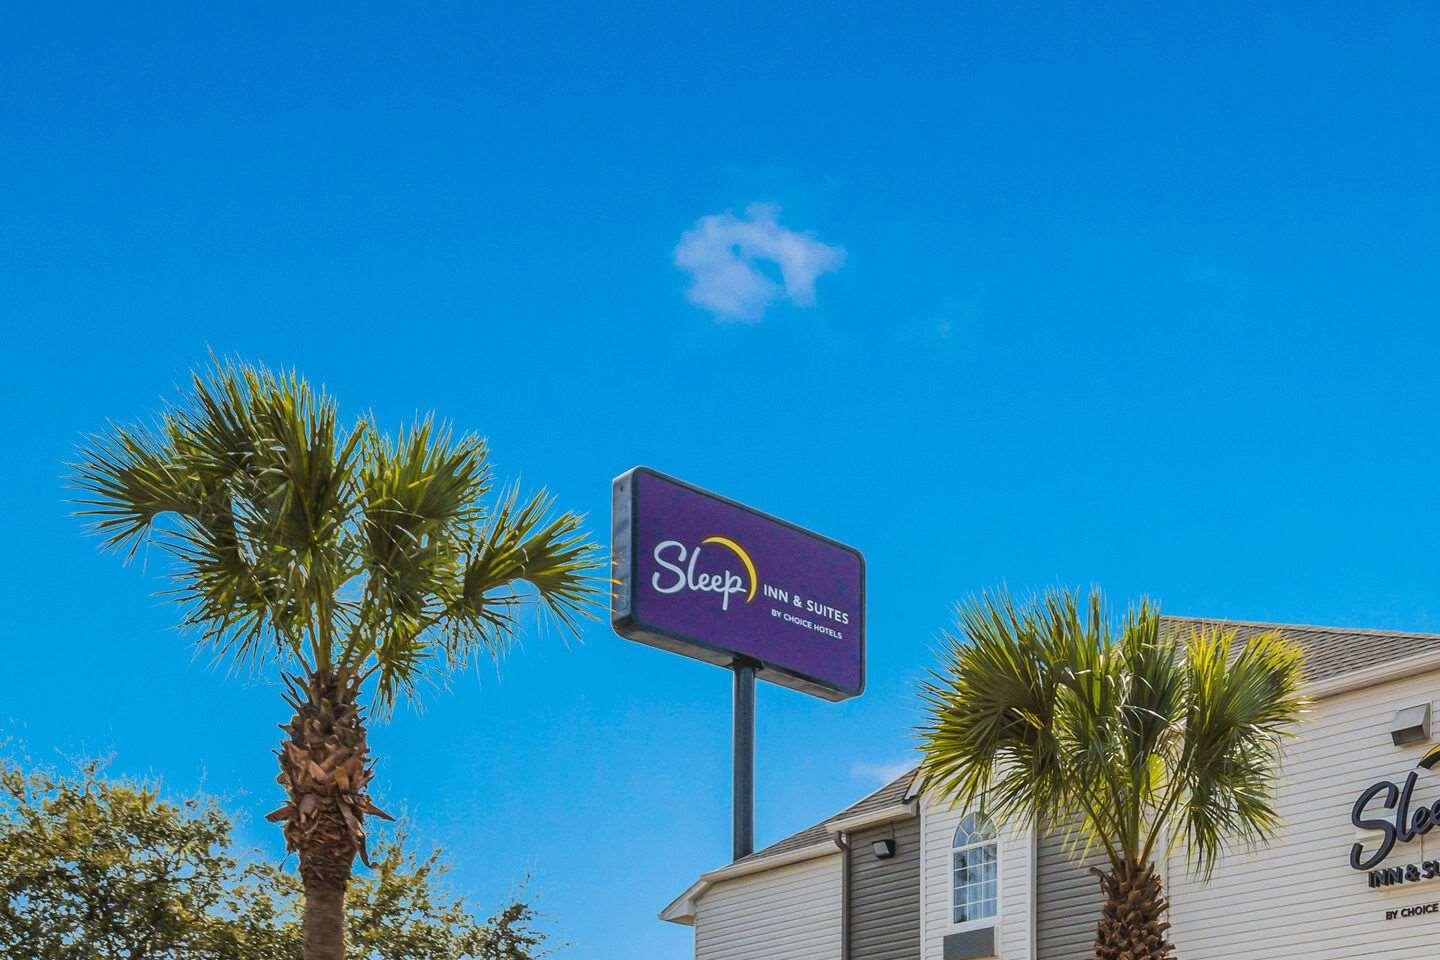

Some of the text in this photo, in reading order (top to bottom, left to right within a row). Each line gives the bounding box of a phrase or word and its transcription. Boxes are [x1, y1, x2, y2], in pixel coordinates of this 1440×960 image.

[652, 540, 747, 611] Sleep
[763, 583, 849, 625] INN & SUITES
[771, 608, 842, 640] BY CHOICE HOTELS
[1368, 866, 1403, 888] INN
[1405, 863, 1421, 882] &
[1385, 910, 1398, 920] BY
[1401, 903, 1439, 918] CHOICE
